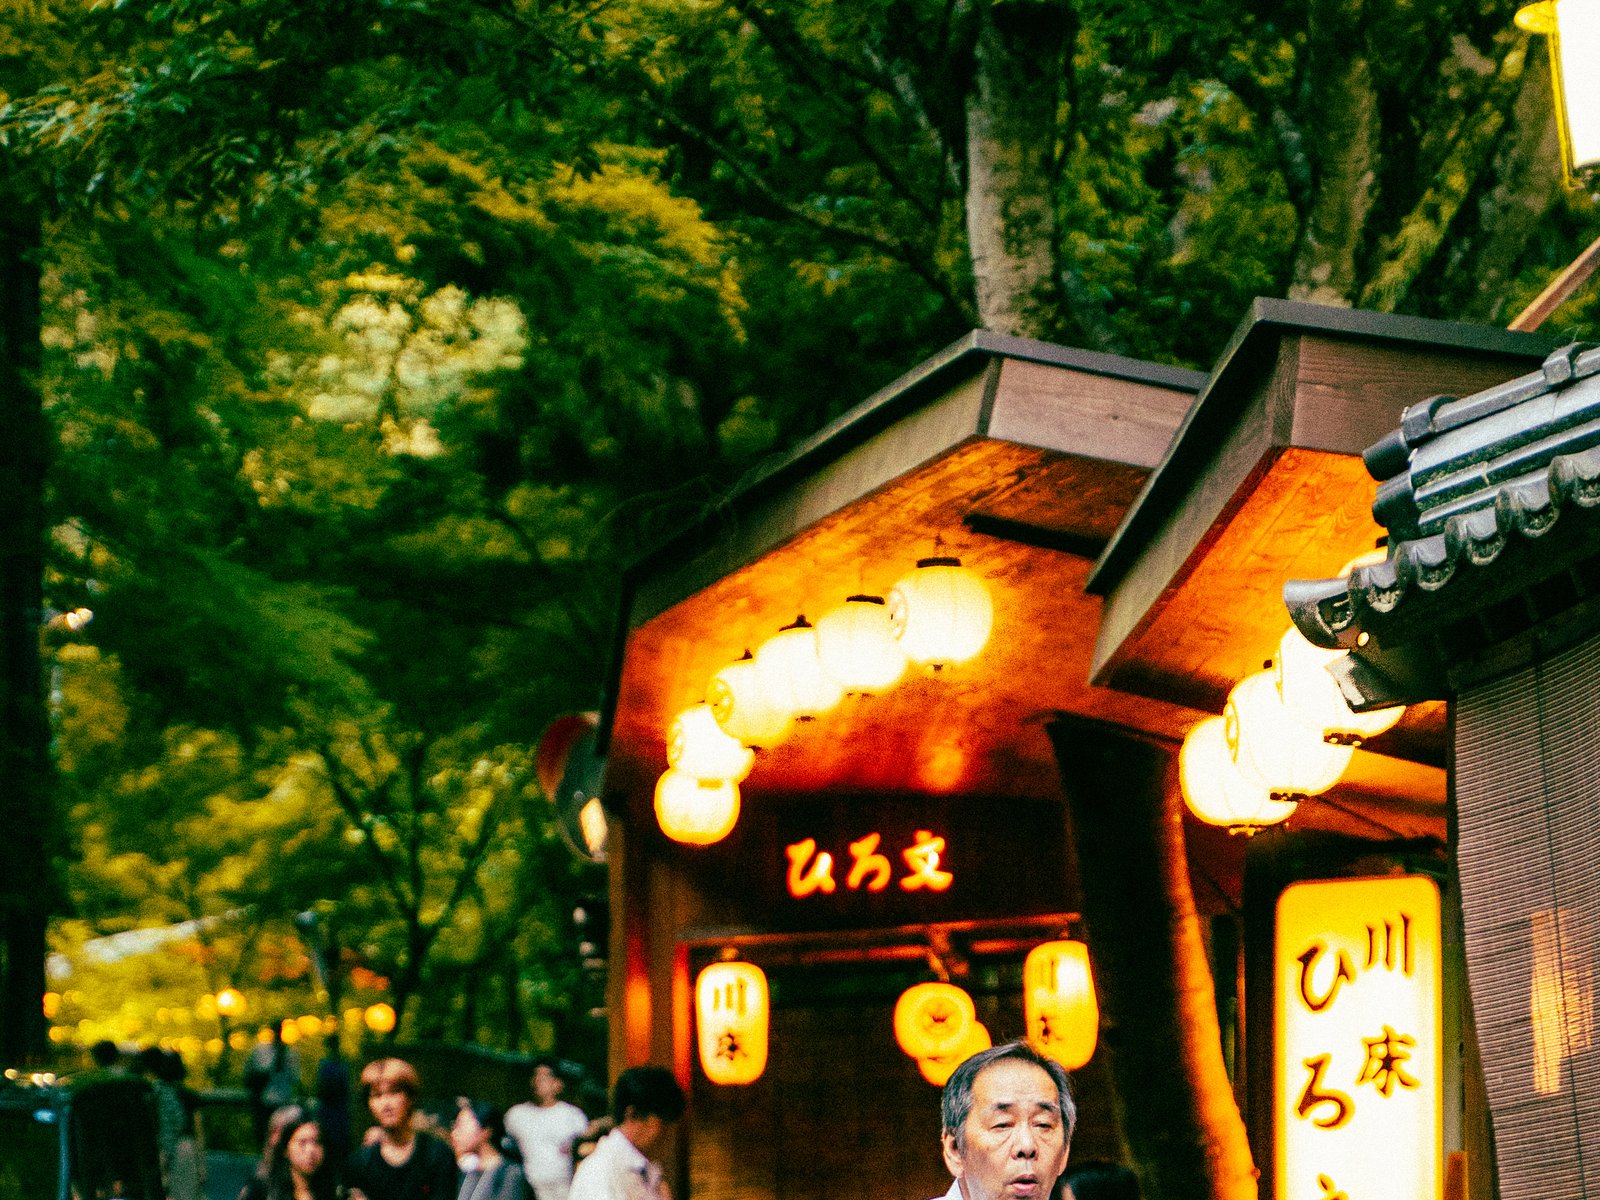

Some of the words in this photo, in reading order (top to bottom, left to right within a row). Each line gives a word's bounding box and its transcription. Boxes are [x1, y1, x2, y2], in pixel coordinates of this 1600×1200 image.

[786, 830, 953, 897] ひろ文
[1356, 913, 1419, 1097] 川床
